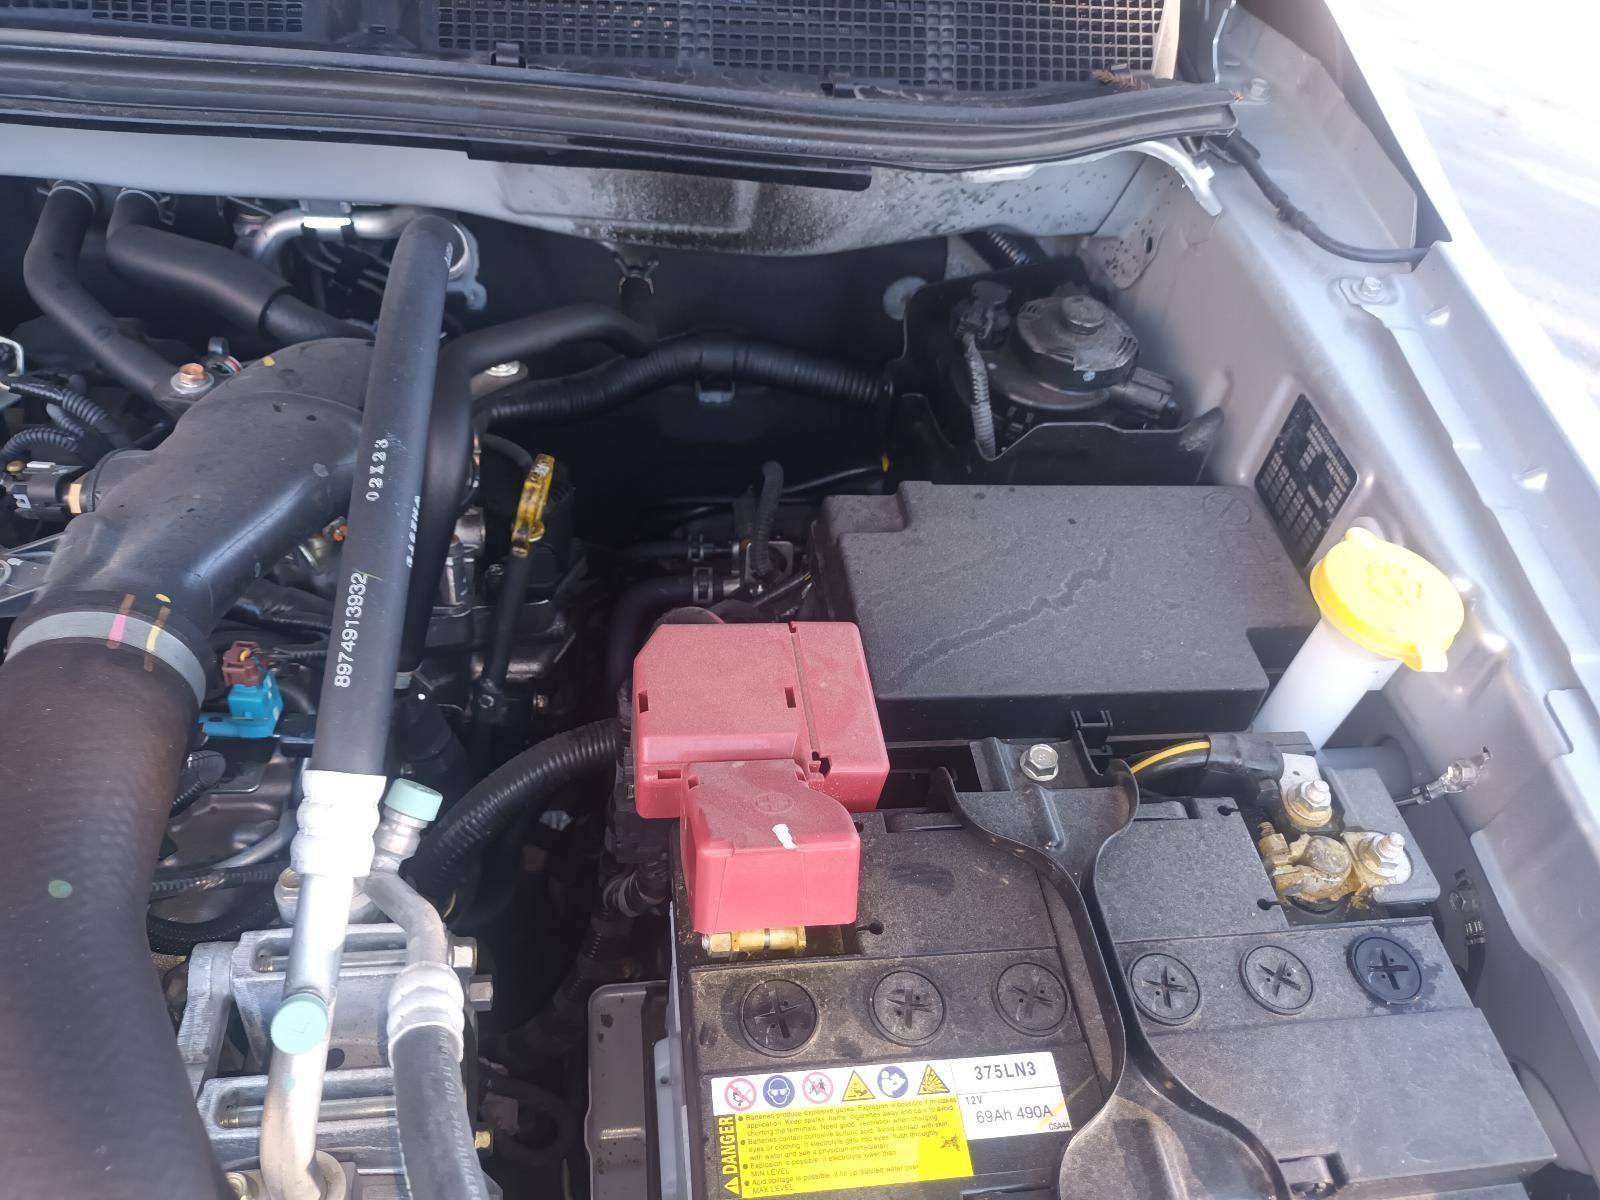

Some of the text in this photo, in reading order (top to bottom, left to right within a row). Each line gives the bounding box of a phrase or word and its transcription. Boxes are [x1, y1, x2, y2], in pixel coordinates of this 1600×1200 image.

[334, 572, 368, 688] 8974913932
[974, 1061, 1037, 1081] 375LN3
[965, 1095, 983, 1105] 12V
[975, 1104, 1054, 1124] 69Ah 490A
[860, 1118, 891, 1127] ventilation
[718, 1116, 739, 1175] DANGER
[846, 1138, 859, 1146] gets
[818, 1146, 849, 1155] physician
[750, 1161, 782, 1169] Explosion
[768, 1176, 794, 1184] spillage
[752, 1186, 769, 1194] MAX
